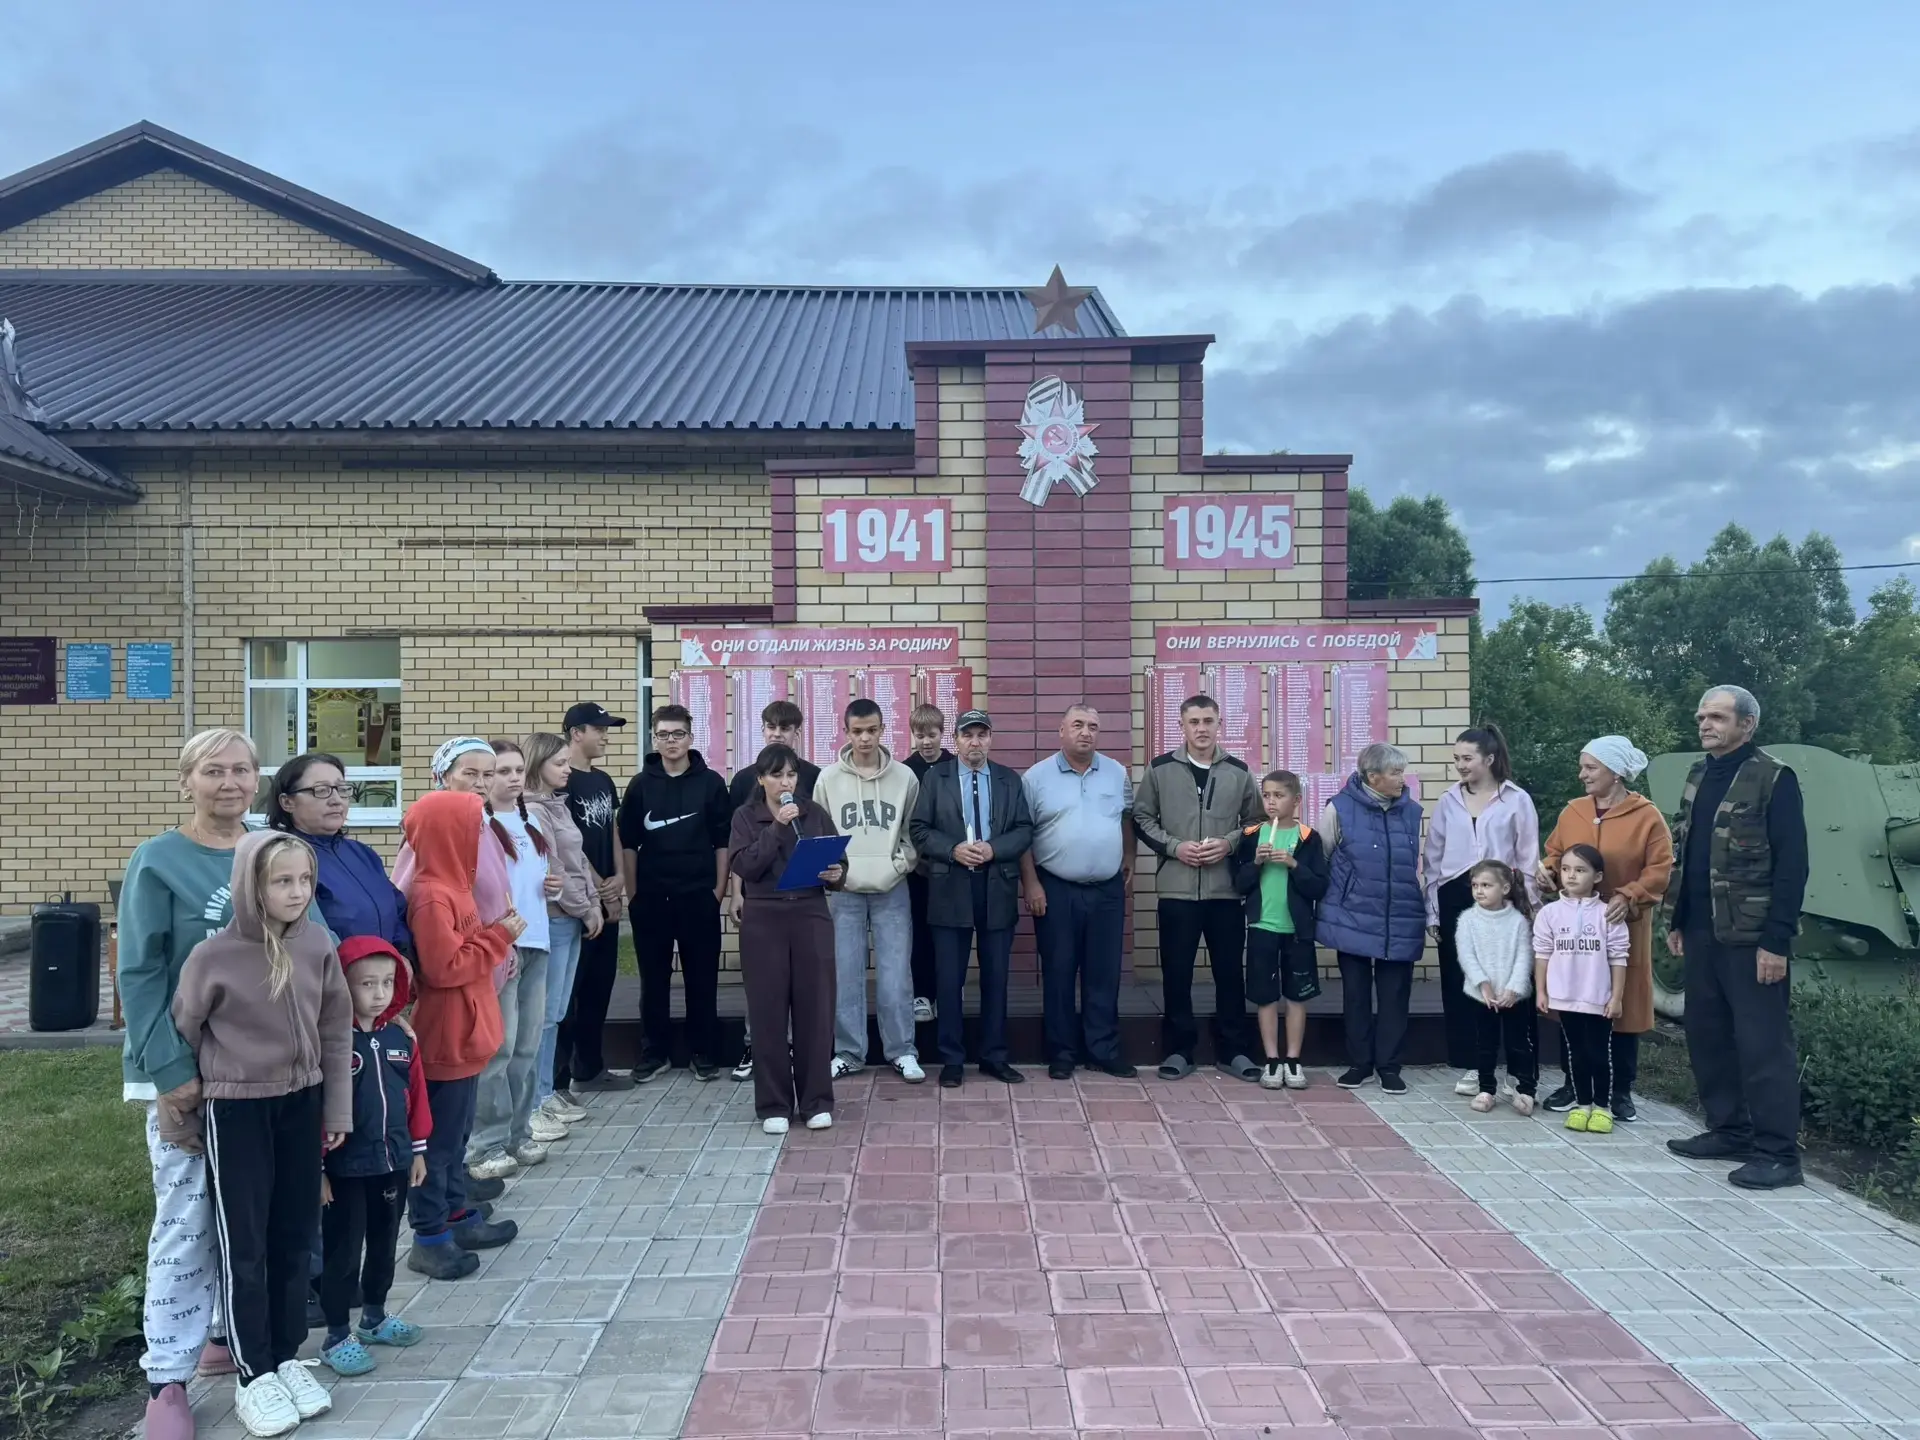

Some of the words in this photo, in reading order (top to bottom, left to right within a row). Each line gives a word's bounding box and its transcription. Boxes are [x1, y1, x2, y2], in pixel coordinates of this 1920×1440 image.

[825, 508, 945, 562] 1941
[1168, 505, 1292, 559] 1945
[711, 639, 744, 653] ОНИ
[747, 638, 809, 655] ОТДАЛИ
[812, 638, 865, 652] ЖИЗНЬ
[868, 638, 886, 652] ЗА
[890, 637, 952, 654] РОДИНУ
[1166, 636, 1201, 649] ОНИ
[1207, 635, 1300, 649] ВЕРНУЛИСЬ
[1306, 635, 1317, 648] С
[1323, 631, 1402, 650] ПОБЕДОЙ
[841, 800, 896, 830] GAP
[204, 883, 231, 921] MICH
[1578, 939, 1601, 951] CLUB
[168, 1177, 194, 1188] YALE
[153, 1257, 181, 1267] YALE
[173, 1266, 203, 1283] YALE
[151, 1296, 178, 1307] YALE
[171, 1304, 201, 1321] YALE
[147, 1335, 177, 1345] YALE
